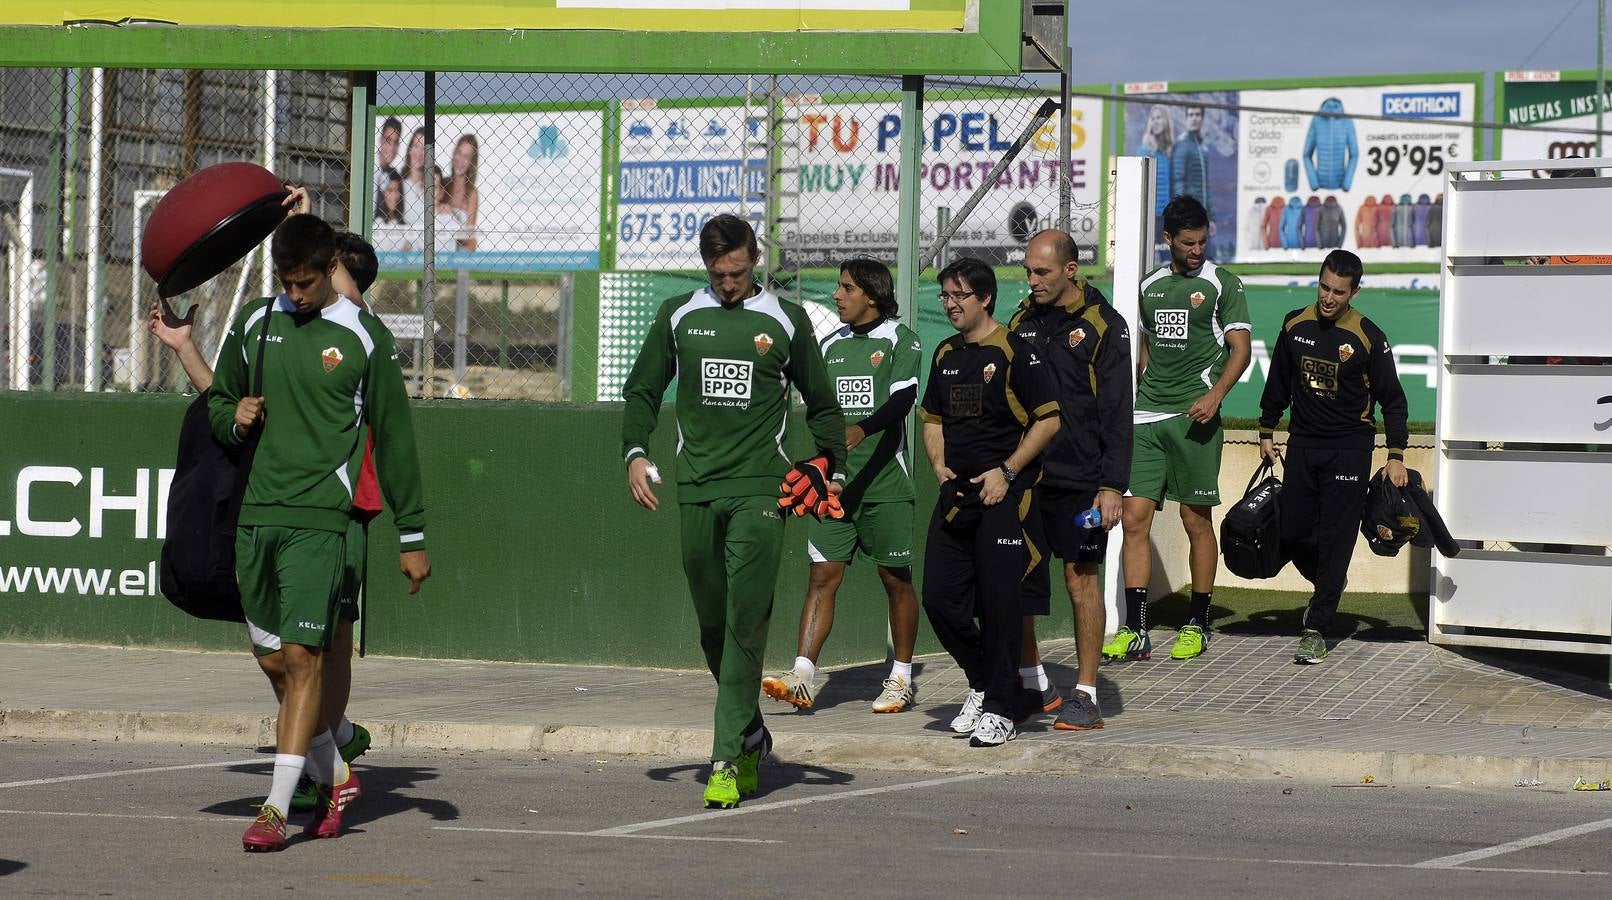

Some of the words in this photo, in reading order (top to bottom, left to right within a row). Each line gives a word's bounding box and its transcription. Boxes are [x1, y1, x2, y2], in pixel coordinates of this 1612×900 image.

[1385, 95, 1457, 114] DECATHLON
[1508, 100, 1562, 125] NUEVAS
[1249, 114, 1301, 127] Compacta
[801, 113, 859, 152] TU
[877, 112, 1011, 152] PPEL
[1249, 145, 1278, 157] Ligera
[1447, 142, 1458, 157] €
[621, 166, 674, 199] DINERO
[676, 166, 694, 198] AL
[800, 163, 865, 192] MUY
[620, 212, 662, 241] 675
[786, 230, 839, 244] Papeles
[1157, 312, 1185, 324] GIOS
[257, 334, 284, 343] KLME
[1157, 326, 1185, 336] EPPO
[1294, 335, 1315, 346] KELME
[705, 363, 749, 380] GIOS
[1303, 360, 1335, 376] GIOS
[704, 380, 748, 395] EPPO
[839, 379, 870, 392] GIOS
[839, 394, 871, 405] EPPO
[0, 560, 161, 596] www.el
[298, 621, 326, 631] KELME
